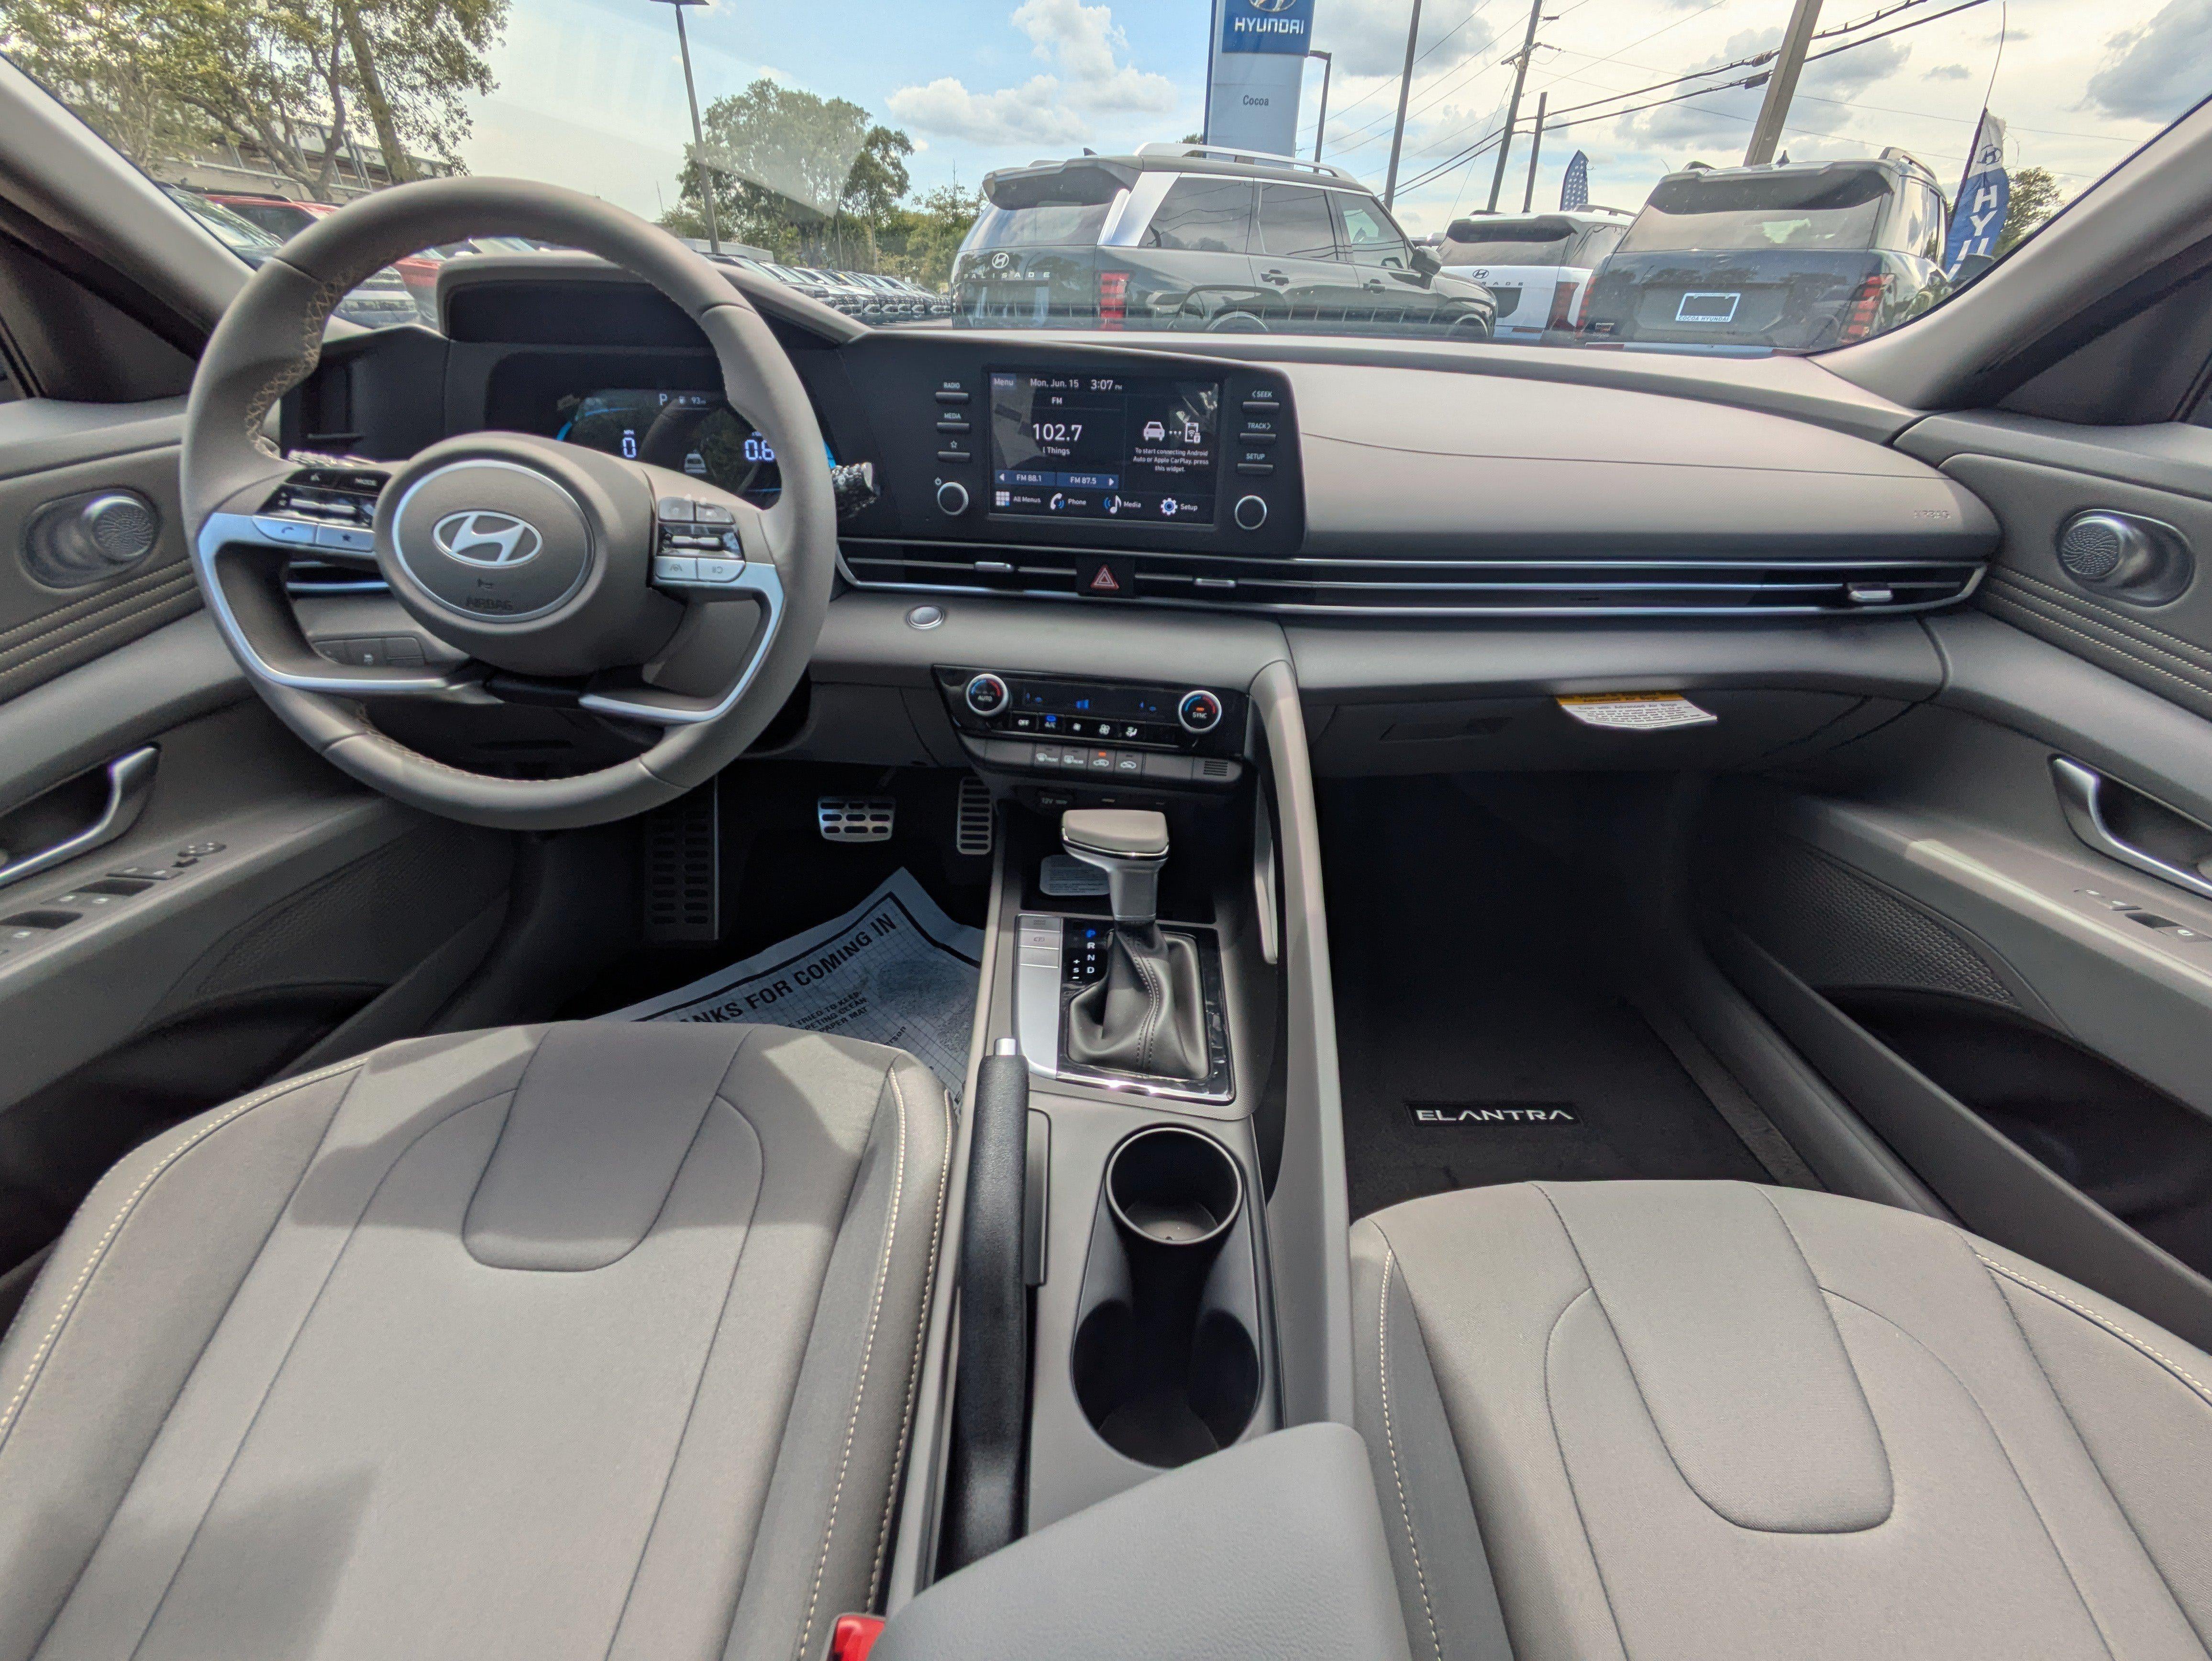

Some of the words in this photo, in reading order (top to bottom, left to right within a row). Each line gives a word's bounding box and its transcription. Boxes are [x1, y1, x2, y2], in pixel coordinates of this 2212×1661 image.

[1235, 17, 1304, 34] HYUNDAI
[1243, 95, 1269, 106] Cocoa
[963, 271, 1050, 279] PALISADE
[994, 377, 1014, 386] Menu
[1069, 379, 1079, 388] 15
[1090, 379, 1114, 390] 3:07
[659, 393, 668, 406] P
[1051, 397, 1063, 405] FM
[1032, 423, 1083, 442] 102.7
[622, 437, 637, 458] 0
[1046, 446, 1071, 455] Things
[1070, 476, 1081, 484] FM
[1180, 503, 1198, 512] Setup
[1085, 929, 1096, 938] P
[744, 980, 793, 1009] FOR
[793, 931, 873, 986] COMING
[870, 913, 896, 936] IN
[838, 997, 867, 1014] CLEAN
[796, 1010, 824, 1025] TRIED
[824, 1004, 837, 1012] TO
[849, 1006, 868, 1019] MAT
[1416, 1109, 1574, 1121] ELANTRA
